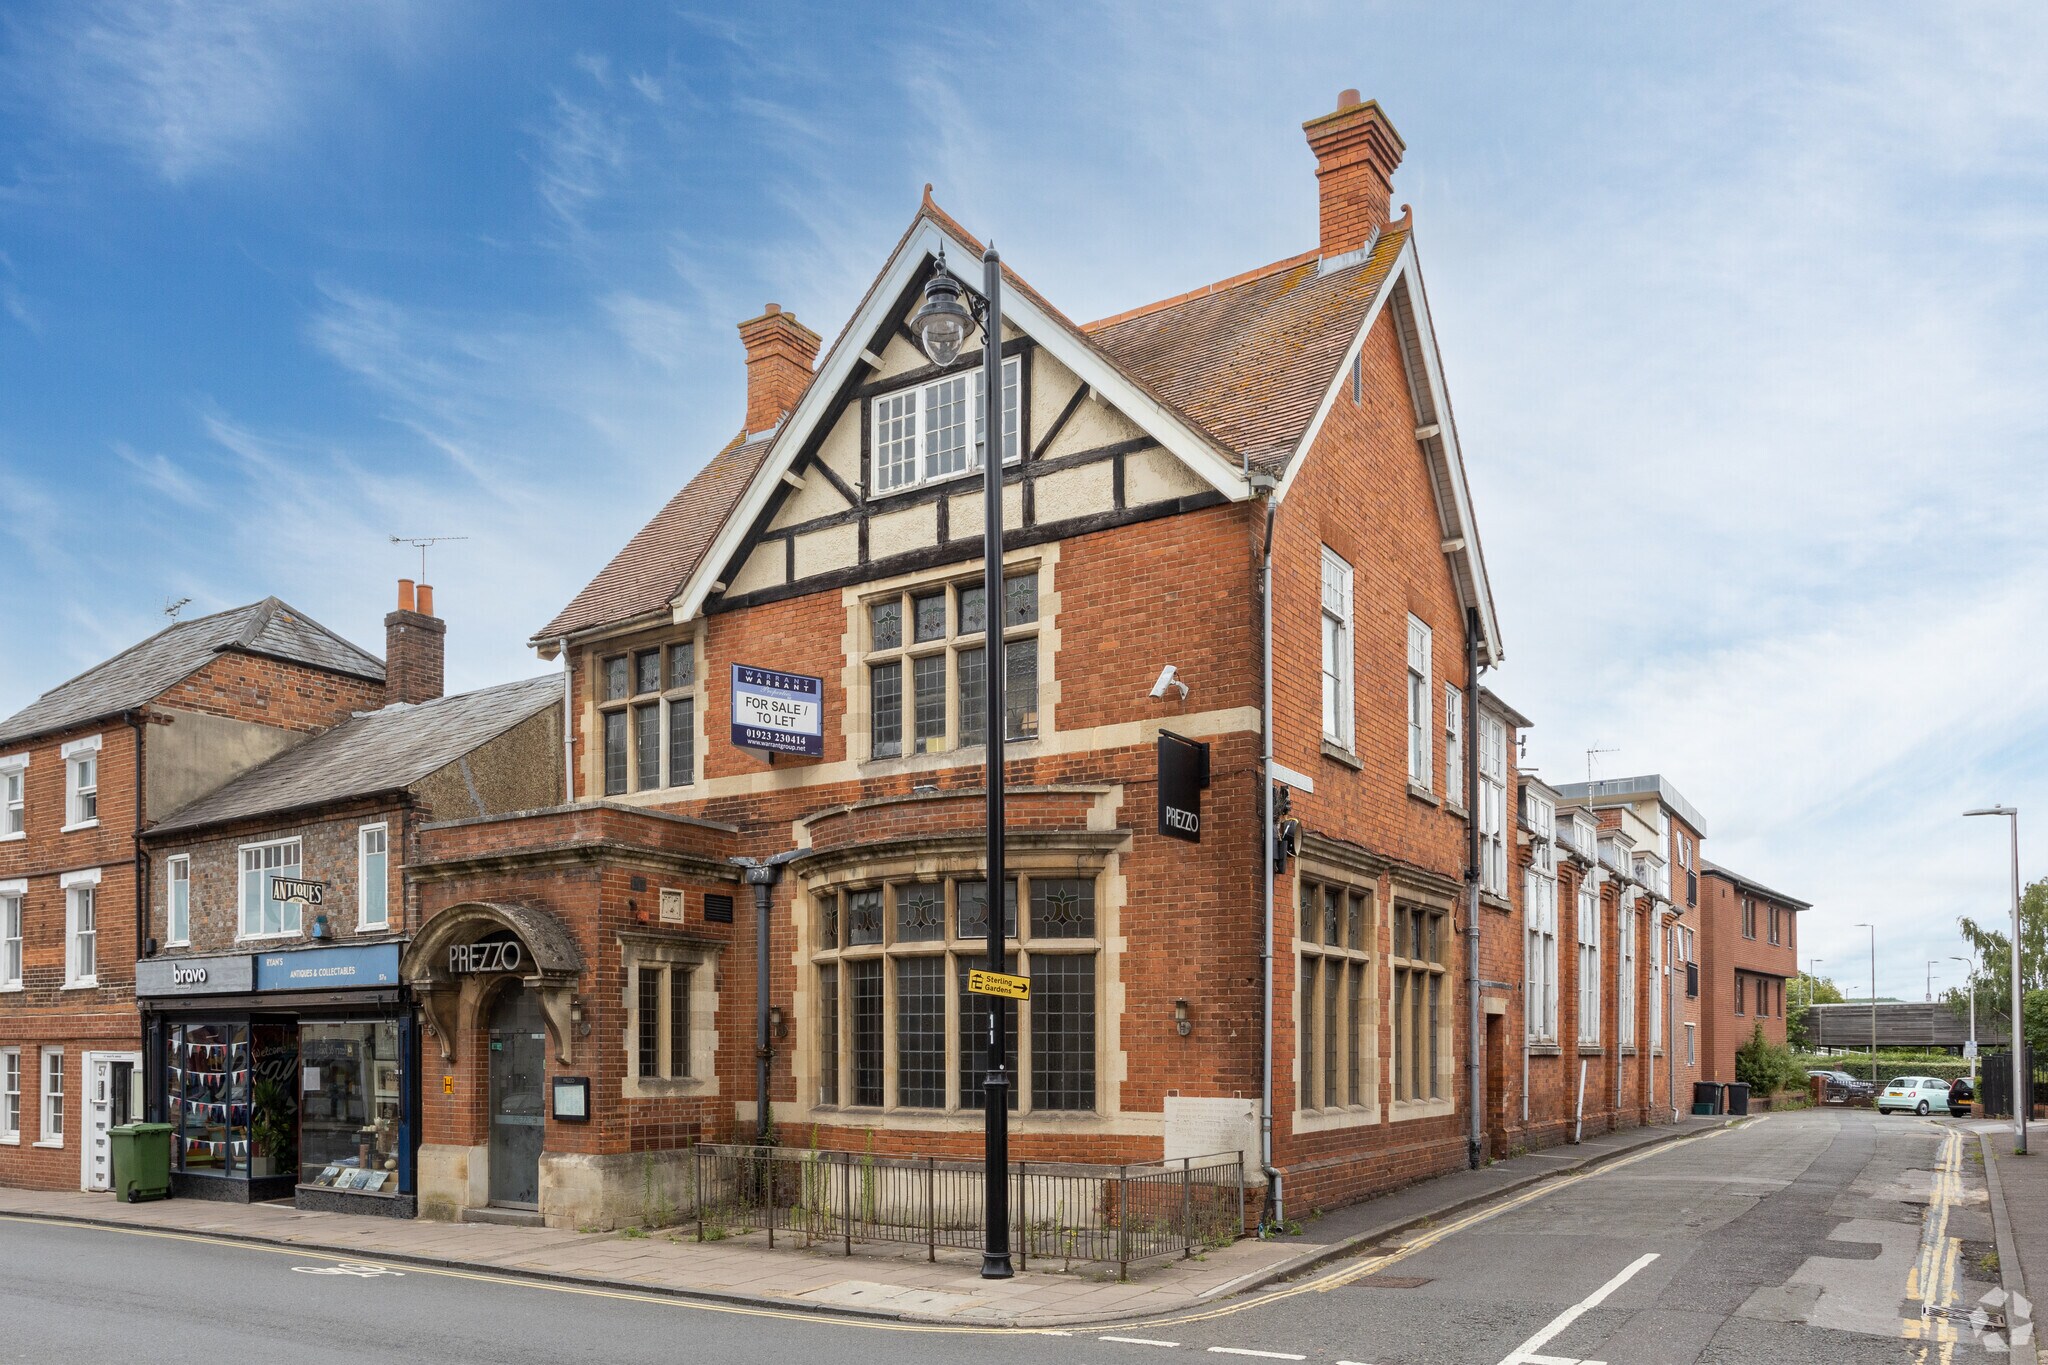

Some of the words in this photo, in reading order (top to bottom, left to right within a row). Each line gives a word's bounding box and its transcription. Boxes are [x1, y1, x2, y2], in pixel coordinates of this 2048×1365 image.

[745, 670, 809, 686] WARRANT
[745, 676, 809, 692] WARRANT
[746, 696, 768, 711] FOR
[771, 701, 801, 715] SALE
[804, 706, 808, 716] /
[757, 712, 772, 724] TO
[774, 715, 796, 727] LET
[746, 728, 772, 741] 01923
[774, 733, 806, 745] 230414
[746, 739, 806, 752] www.warrantgroup.net
[1166, 805, 1199, 833] PREZZO
[273, 880, 322, 904] ANTIQUES
[266, 957, 284, 966] RYAN'S
[449, 941, 521, 973] PREZZO
[173, 963, 206, 984] bravo
[289, 969, 313, 978] ANTIQUES
[313, 969, 318, 977] &
[318, 966, 356, 977] COLLECTABLES
[984, 983, 1012, 994] Gardens
[986, 975, 1013, 987] Sterling
[98, 1065, 107, 1077] 57
